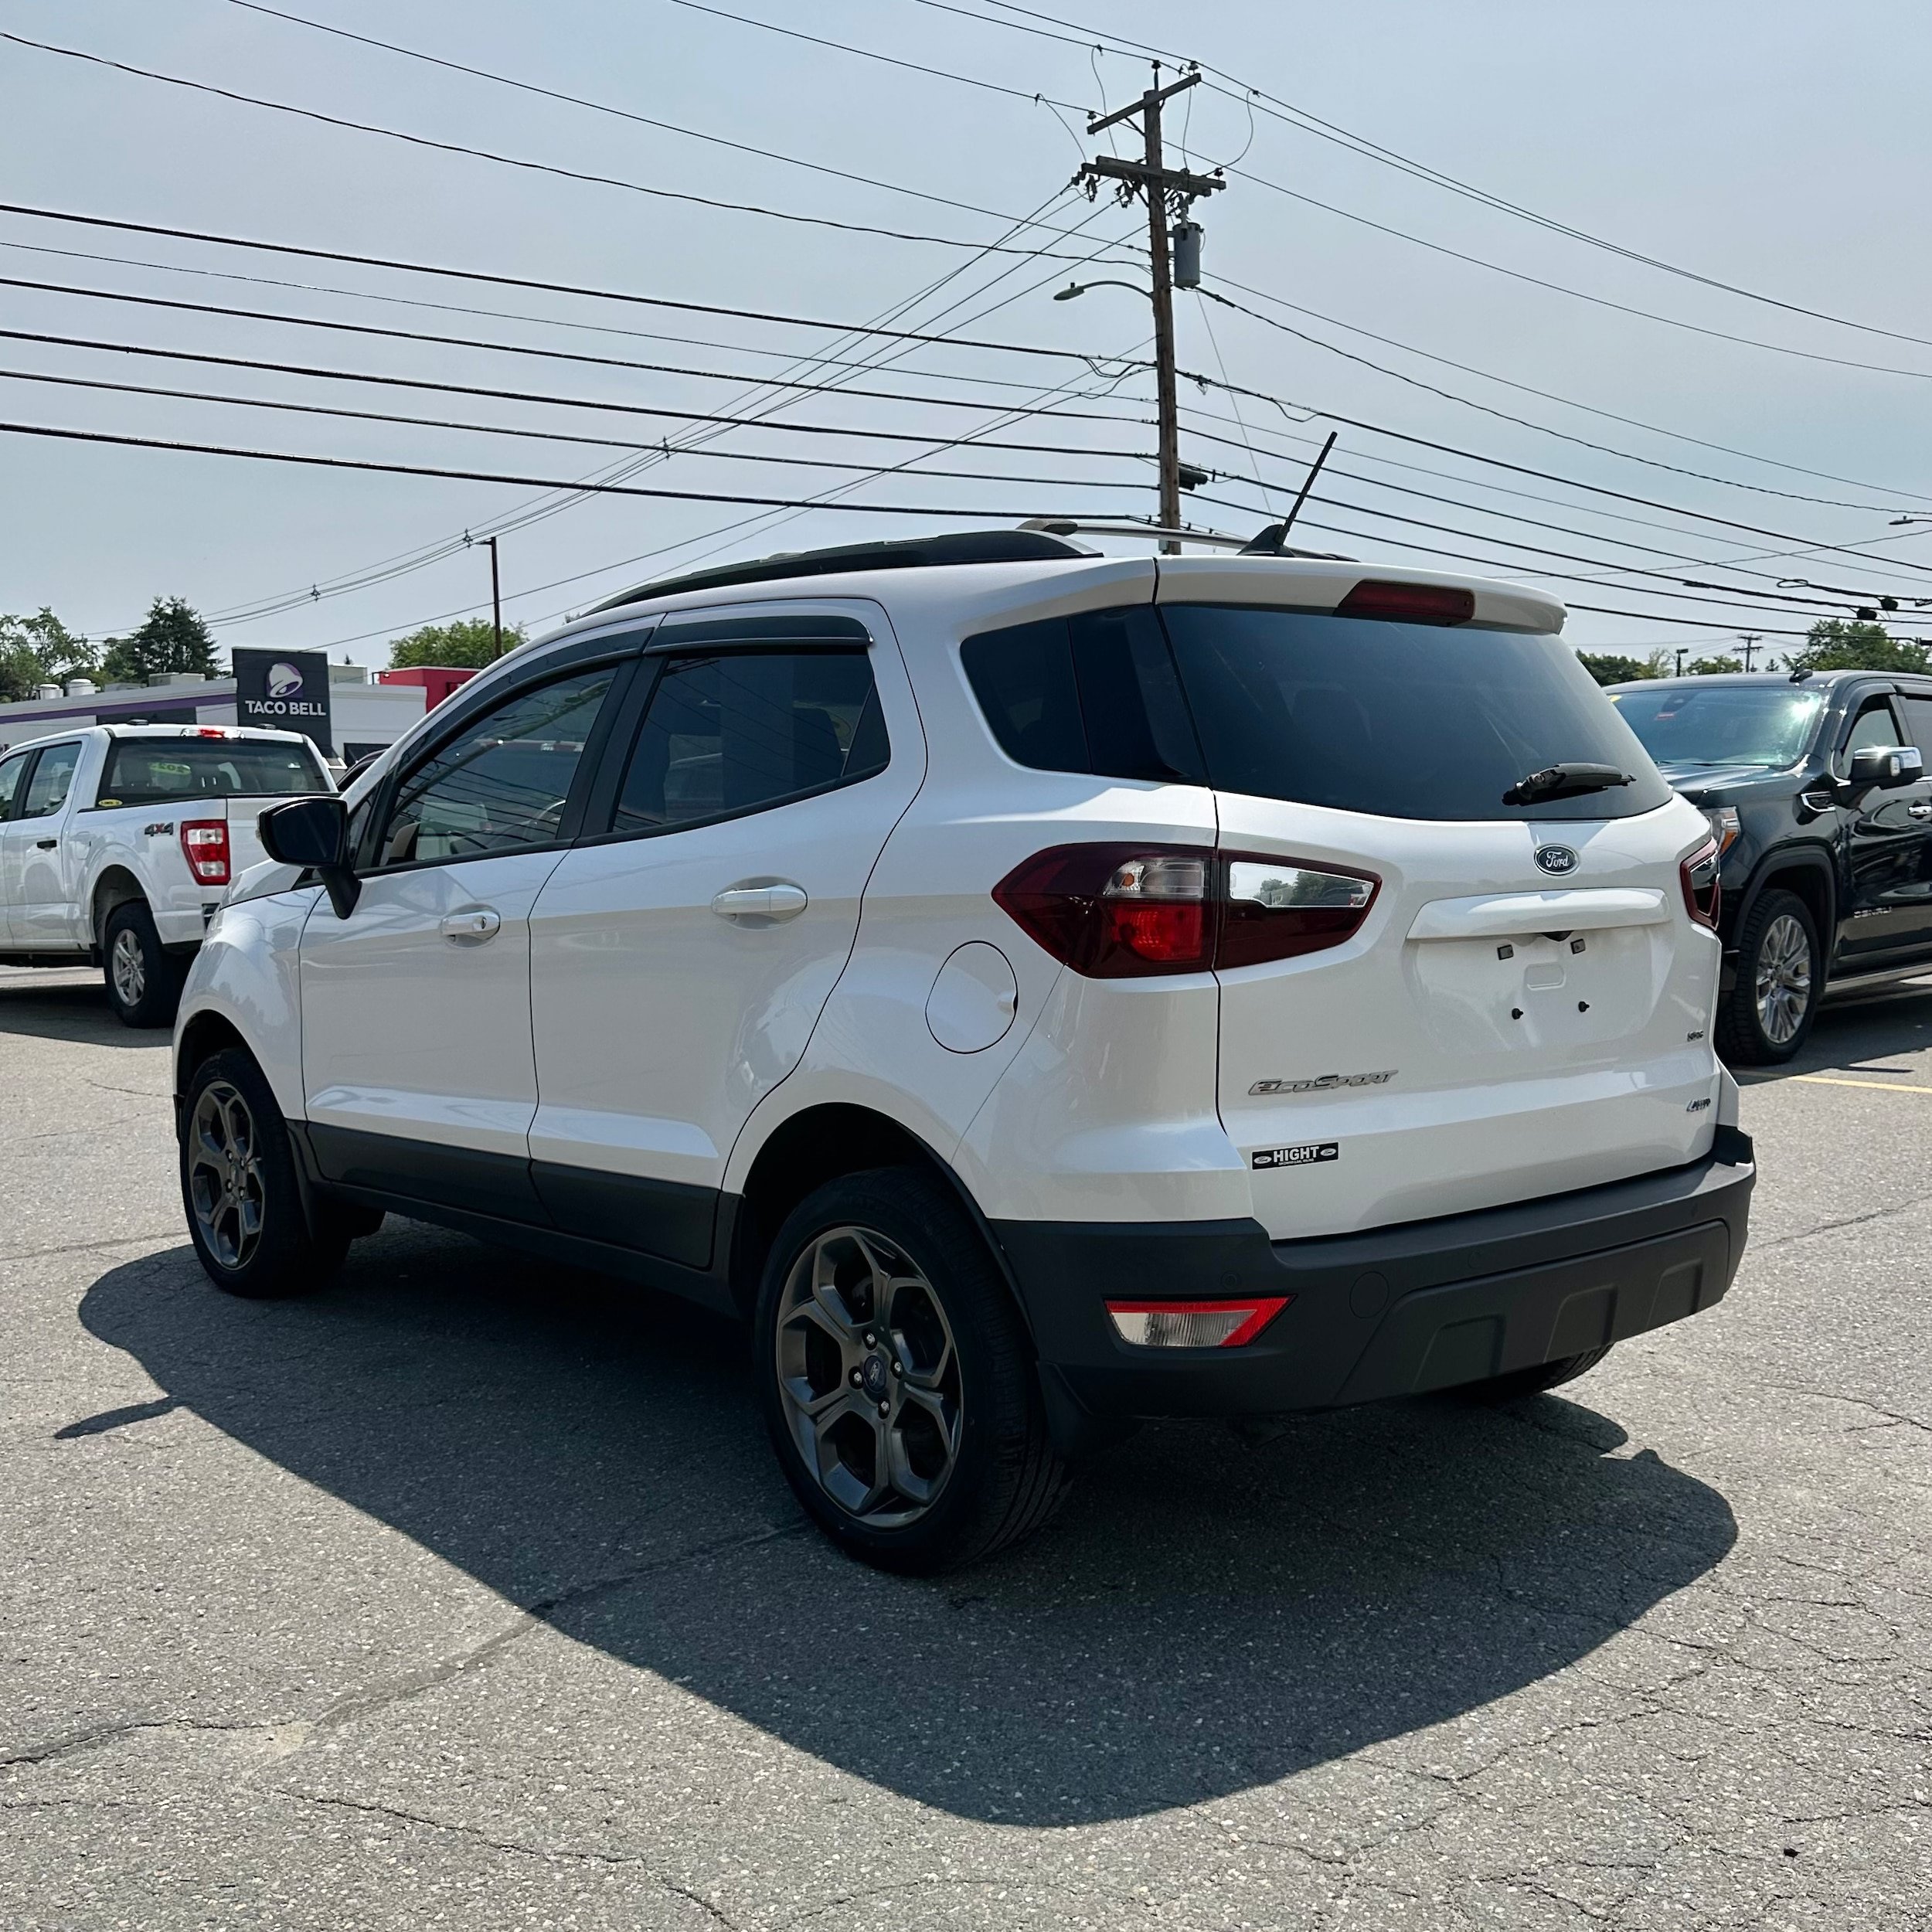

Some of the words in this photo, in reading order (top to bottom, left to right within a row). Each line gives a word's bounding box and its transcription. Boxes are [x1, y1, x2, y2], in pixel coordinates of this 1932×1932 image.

[245, 700, 286, 714] TACO
[289, 702, 326, 716] BELL
[1546, 851, 1570, 867] Ford
[1273, 1146, 1319, 1162] HIGHT
